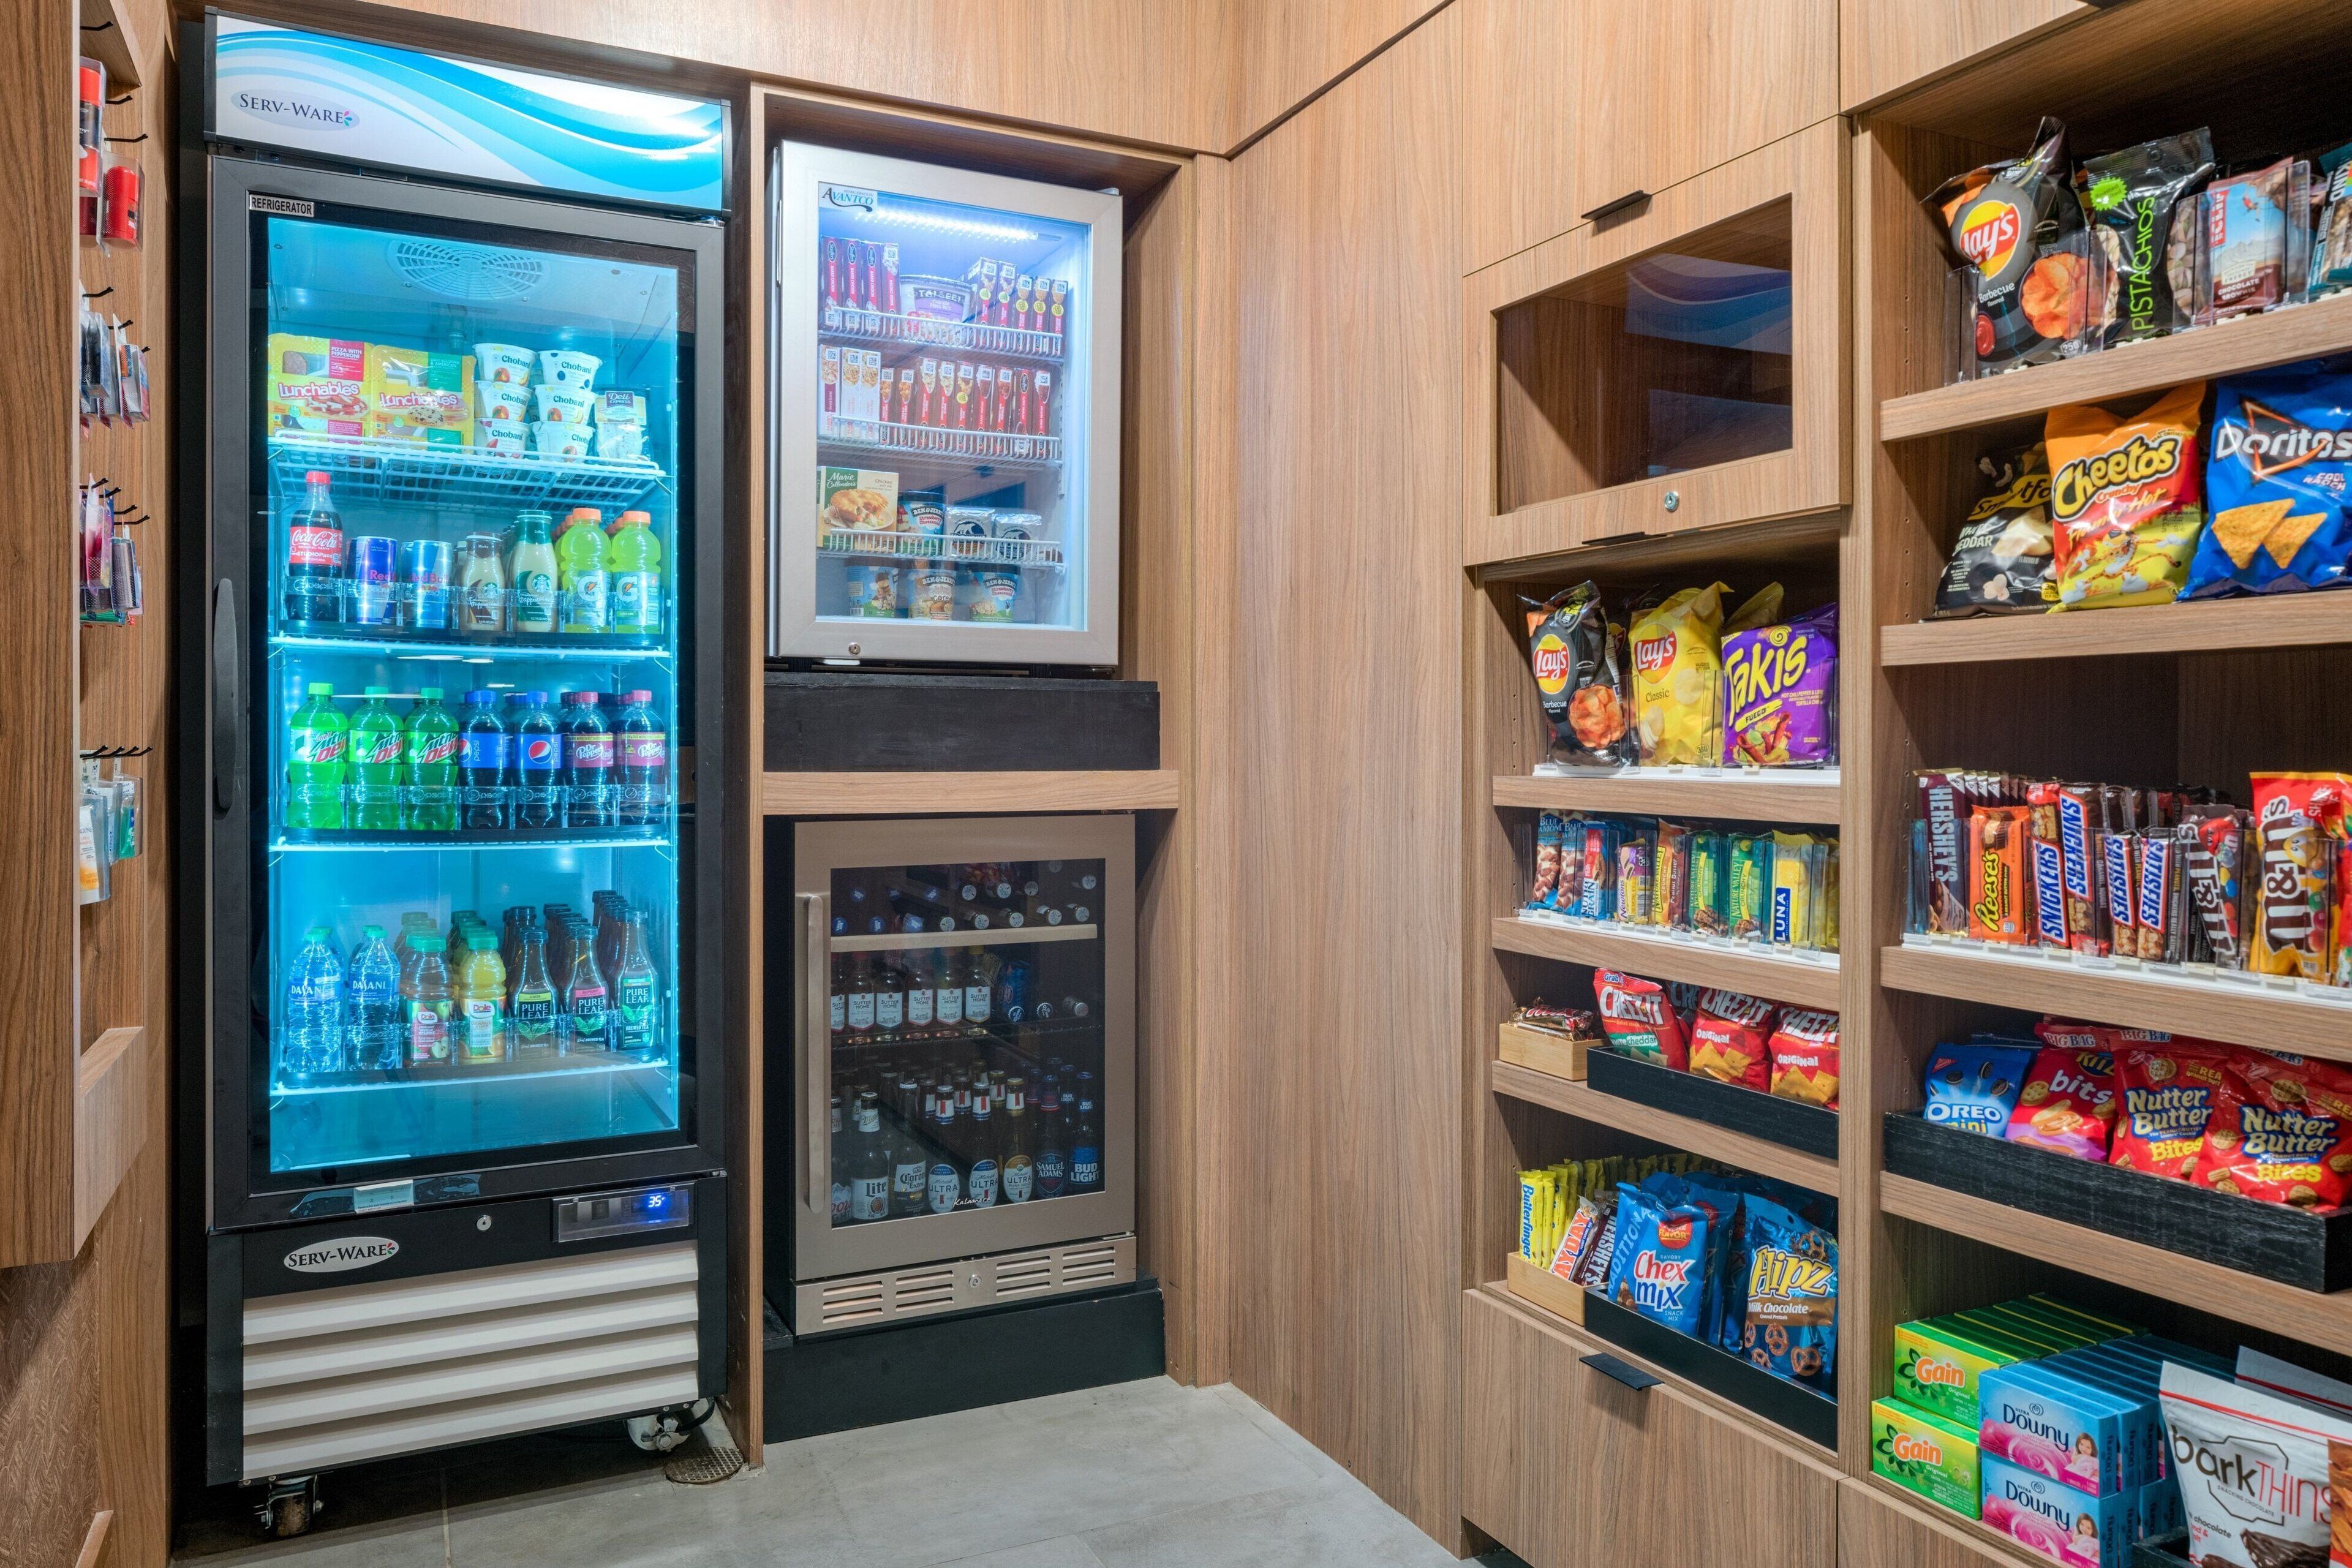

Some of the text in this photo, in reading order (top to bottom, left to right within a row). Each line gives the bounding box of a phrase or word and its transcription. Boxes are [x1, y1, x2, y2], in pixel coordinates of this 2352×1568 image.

[240, 94, 343, 123] SERV-WARE
[2330, 160, 2351, 202] KIND
[252, 197, 312, 214] REFRIGERATOR
[822, 187, 873, 210] AVANTCO
[2129, 197, 2155, 331] PISTACHIOS
[1978, 282, 2015, 304] Barbecue
[2218, 279, 2260, 295] CHOCOLATE
[2222, 287, 2256, 300] BROWNIE
[1988, 296, 2005, 307] Flavored
[502, 355, 531, 368] Chobani
[561, 361, 592, 374] Chobani
[279, 382, 359, 398] Lunchables
[554, 395, 584, 408] Chobani
[492, 430, 523, 441] Chobani
[2216, 427, 2352, 458] Doritos
[828, 472, 854, 481] Marie
[2054, 439, 2174, 516] Cheetos
[2095, 484, 2139, 503] Crunchy
[292, 529, 337, 548] Coca-Cola
[431, 573, 449, 583] Bull
[577, 576, 599, 601] G
[616, 576, 638, 601] G
[1637, 636, 1674, 671] Lay's
[1537, 650, 1568, 680] Lay's
[1725, 636, 1807, 726] Takis
[1646, 689, 1670, 702] Classic
[1746, 708, 1766, 722] FUEGO
[577, 747, 603, 758] Pepper
[586, 744, 597, 753] Dr
[639, 745, 662, 757] Pepper
[648, 742, 657, 752] Dr
[1732, 861, 1741, 917] NATURE VALLEY
[2113, 839, 2129, 923] SATISFIES
[2142, 841, 2164, 927] SATISFIES
[1975, 850, 1999, 932] Reese's
[2037, 845, 2064, 940] SNICKERS
[1776, 893, 1786, 941] LUNA
[1604, 973, 1619, 982] Grab
[522, 1003, 549, 1012] PURE
[579, 998, 604, 1007] PURE
[1626, 1036, 1657, 1046] cheddar
[2045, 1033, 2095, 1046] BIG BAG
[2120, 1030, 2171, 1042] BIG BAG
[2049, 1069, 2113, 1102] bits
[2126, 1090, 2207, 1114] Nutter
[1928, 1103, 2001, 1121] OREO
[2135, 1107, 2213, 1134] Butter
[2242, 1107, 2335, 1137] Nutter
[2149, 1137, 2204, 1161] Bites
[2244, 1133, 2335, 1156] Butter
[1036, 1161, 1064, 1170] SAMUEL
[1074, 1163, 1098, 1172] BUD
[2258, 1164, 2321, 1182] Bites
[971, 1178, 998, 1188] ULTRA
[1071, 1172, 1099, 1182] LIGHT
[866, 1182, 886, 1197] Lite
[953, 1197, 991, 1208] Kalamera
[1522, 1184, 1534, 1259] Butterfinger
[288, 1244, 386, 1267] SERV-WARE
[1553, 1213, 1589, 1279] AYDAY
[1635, 1252, 1690, 1281] Chex
[1749, 1248, 1832, 1297] Flipz
[1637, 1281, 1684, 1309] mix
[1749, 1302, 1809, 1314] Milk Chocolate
[1916, 1357, 1964, 1388] Gain
[1948, 1387, 1970, 1400] Original
[2016, 1407, 2029, 1416] ULTRA
[2003, 1404, 2069, 1452] Downy
[1894, 1433, 1942, 1466] Gain
[1926, 1464, 1948, 1478] Original
[2018, 1485, 2031, 1494] ULTRA
[2006, 1480, 2070, 1531] Downy
[2217, 1485, 2275, 1517] SNACKING CHOCOLATE
[2194, 1515, 2231, 1538] chocolate
